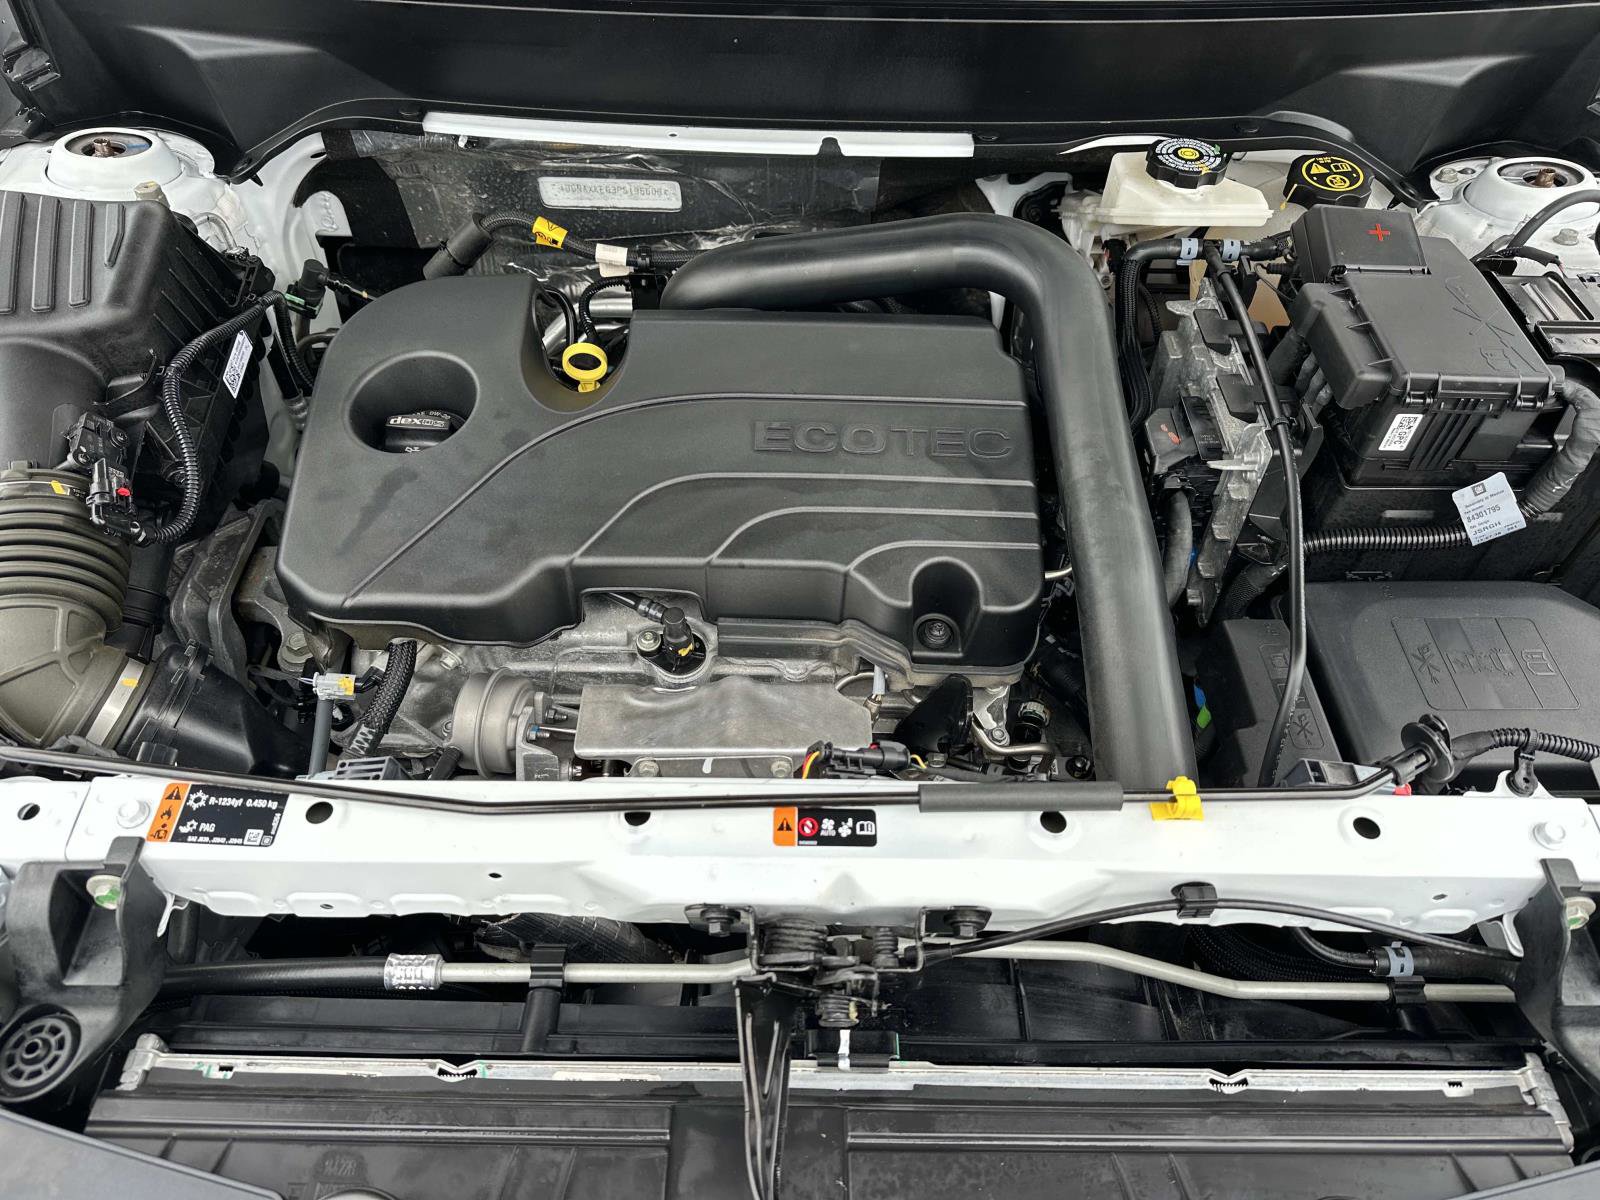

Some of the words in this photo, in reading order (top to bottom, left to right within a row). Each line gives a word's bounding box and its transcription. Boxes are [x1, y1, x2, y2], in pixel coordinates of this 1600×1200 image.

[389, 416, 446, 428] dexos
[753, 420, 1015, 459] ECOTEC
[1466, 504, 1502, 523] 84301795
[208, 797, 243, 808] R-1234yf
[246, 799, 268, 808] 0.450
[267, 800, 279, 810] kg
[198, 822, 216, 833] PAG
